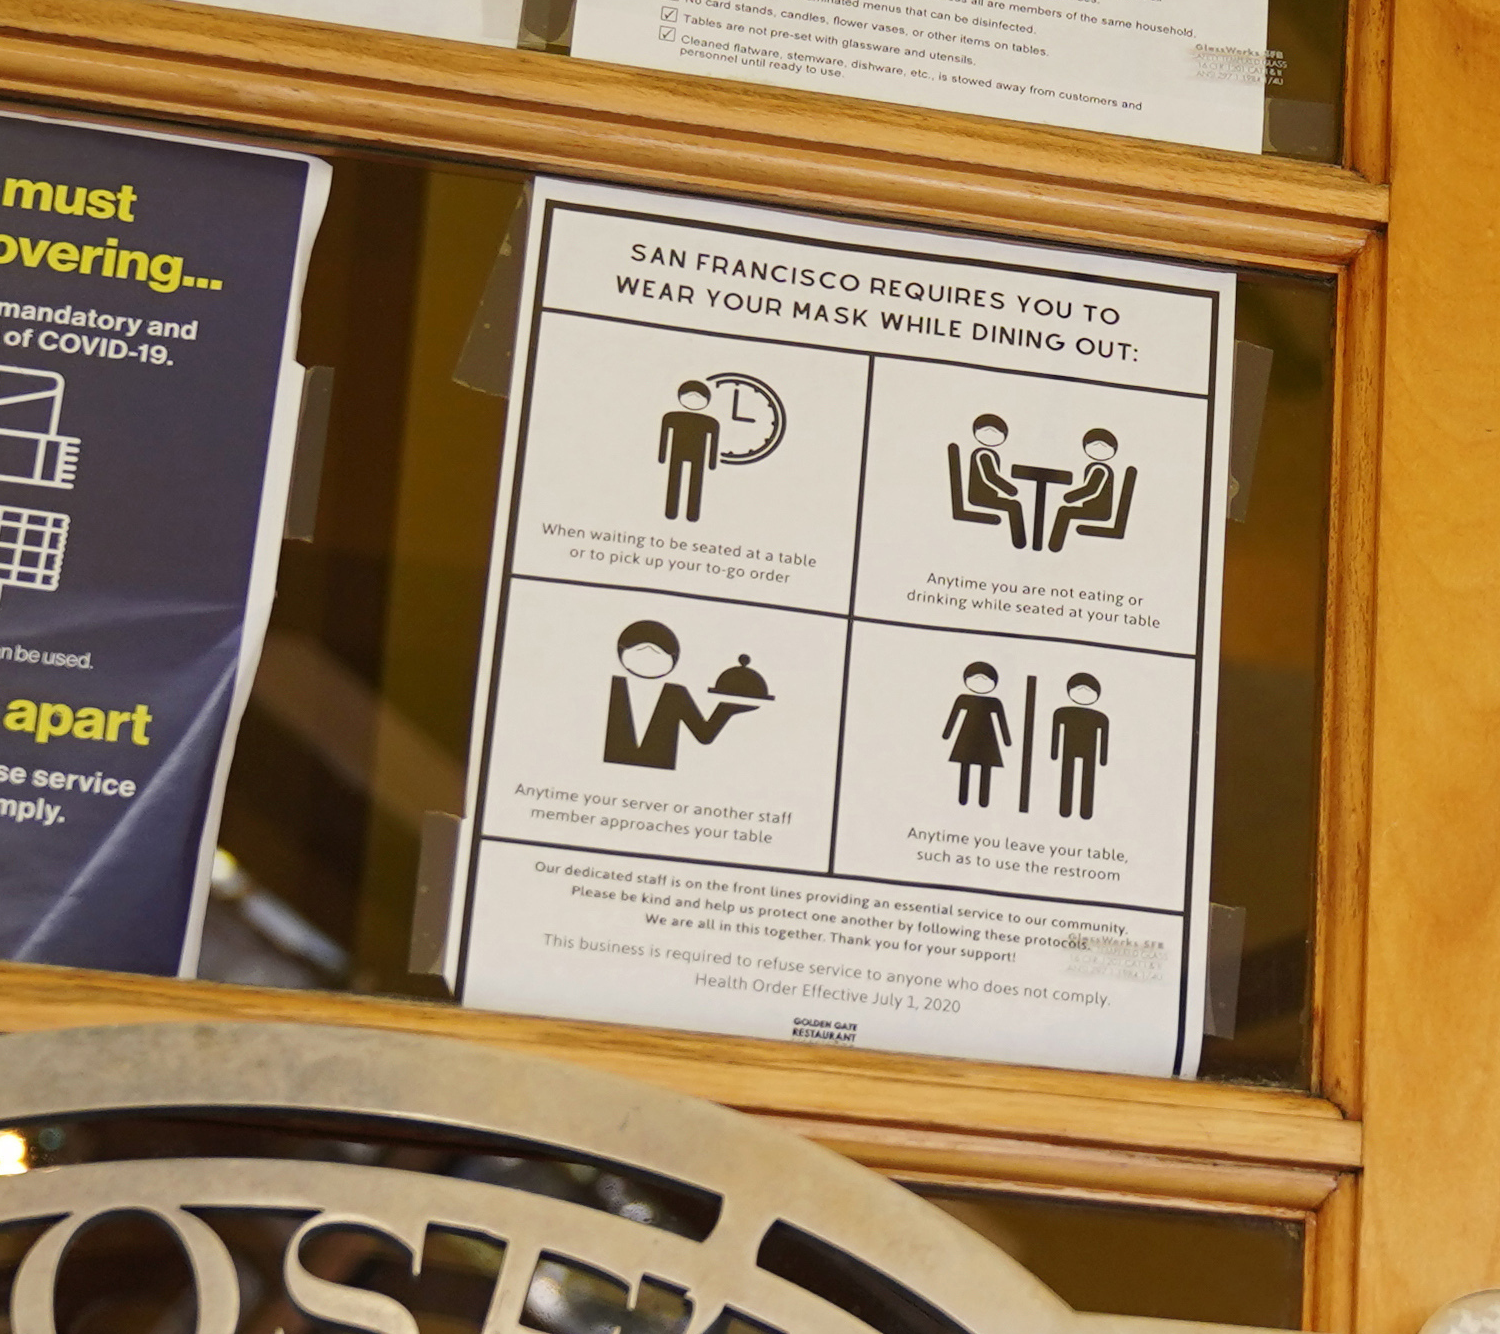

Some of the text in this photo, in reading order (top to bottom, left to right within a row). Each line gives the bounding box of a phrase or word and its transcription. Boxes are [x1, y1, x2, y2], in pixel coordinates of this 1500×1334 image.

[1, 177, 138, 223] must
[630, 243, 1121, 326] SAN FRANCISCO REQUIRES YOU TO
[146, 319, 199, 341] and
[616, 274, 1139, 363] WEAR YOUR MASK WHILE DINING OUT:
[2, 327, 35, 348] of
[37, 329, 174, 367] COVID-19.
[541, 522, 817, 569] When waiting to be seated at a table
[568, 548, 791, 584] or to pick up your to-go order
[906, 588, 1161, 630] drinking while seated at your table
[926, 572, 1144, 608] Anytime you are not eating or
[13, 644, 41, 664] be
[40, 651, 94, 670] used.
[2, 698, 153, 747] apart
[31, 768, 137, 798] service
[514, 782, 793, 826] Anytime your server or another staff
[530, 808, 773, 845] member approaches your table
[906, 826, 1129, 864] Anytime you leave your table,
[916, 849, 1121, 882] such as to use the restroom
[694, 972, 962, 1014] Health Order Effective July 1, 2020
[791, 1027, 856, 1042] RESTAURANT
[792, 1017, 858, 1032] GOLDEN GATE
